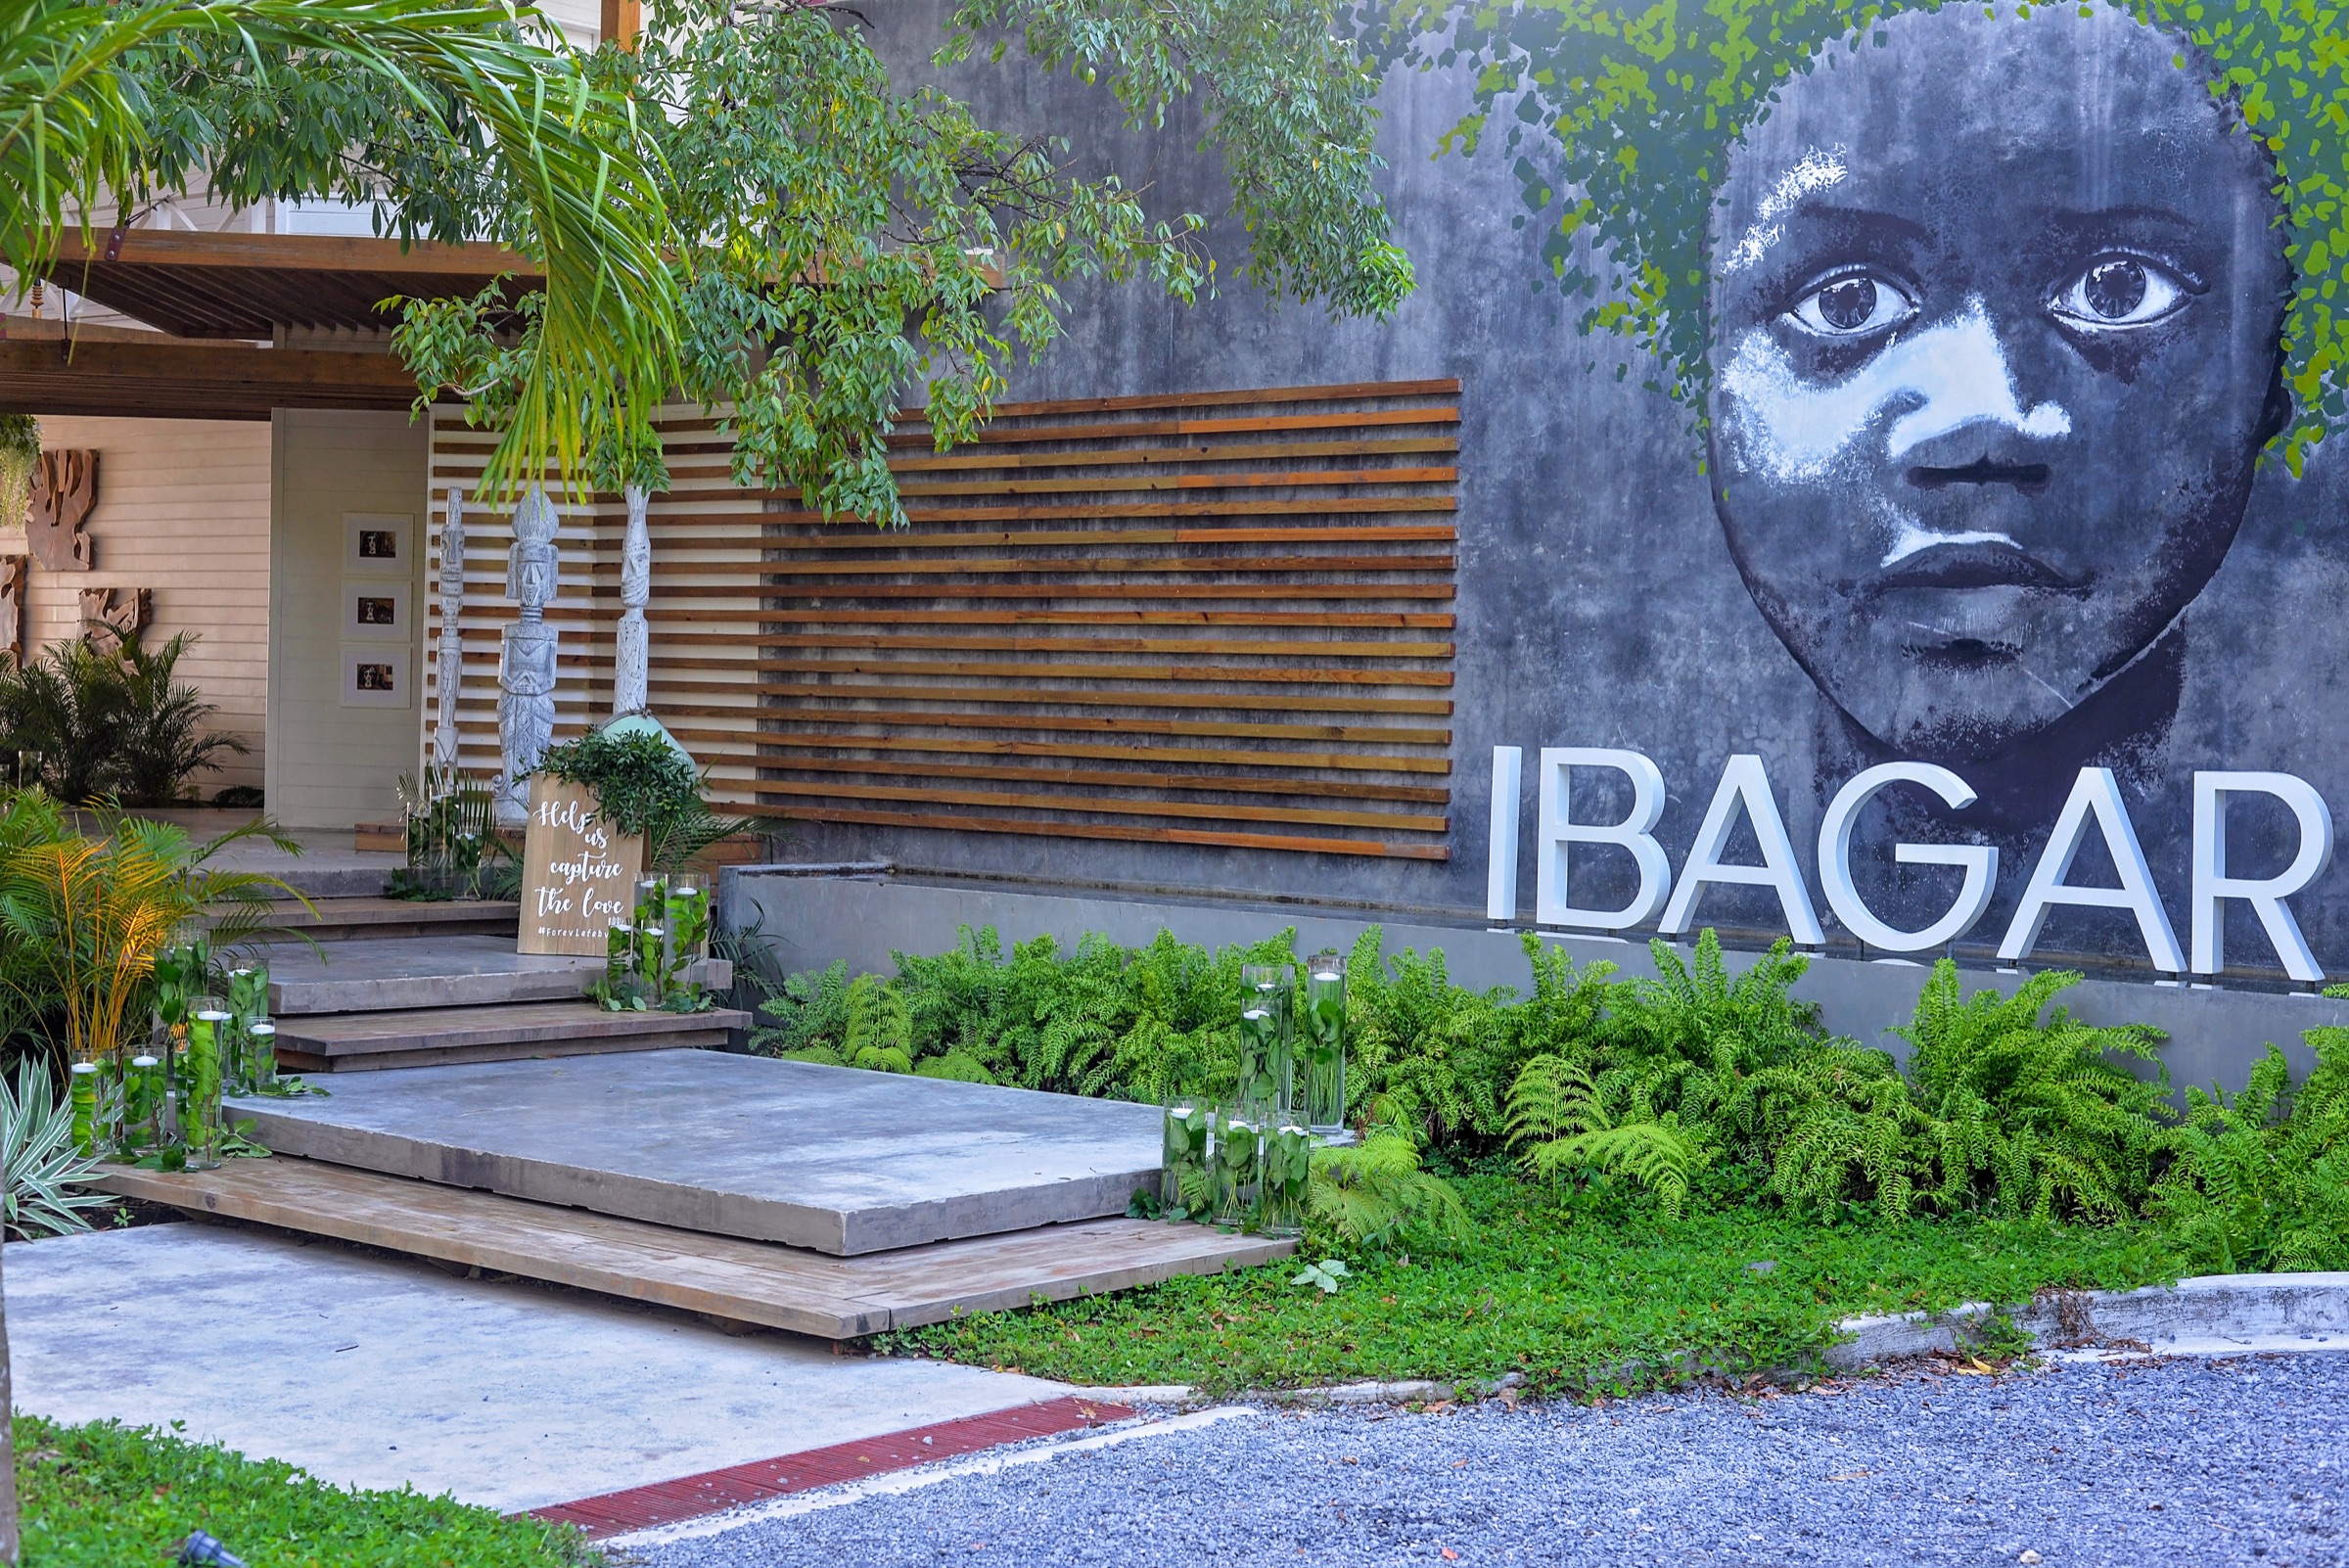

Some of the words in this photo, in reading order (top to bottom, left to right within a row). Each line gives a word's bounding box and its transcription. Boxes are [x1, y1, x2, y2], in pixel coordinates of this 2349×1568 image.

[532, 800, 593, 835] Help
[584, 827, 610, 850] us
[550, 851, 623, 885] capture
[1487, 745, 2333, 982] IBAGAR
[534, 886, 575, 918] the
[582, 887, 624, 918] love
